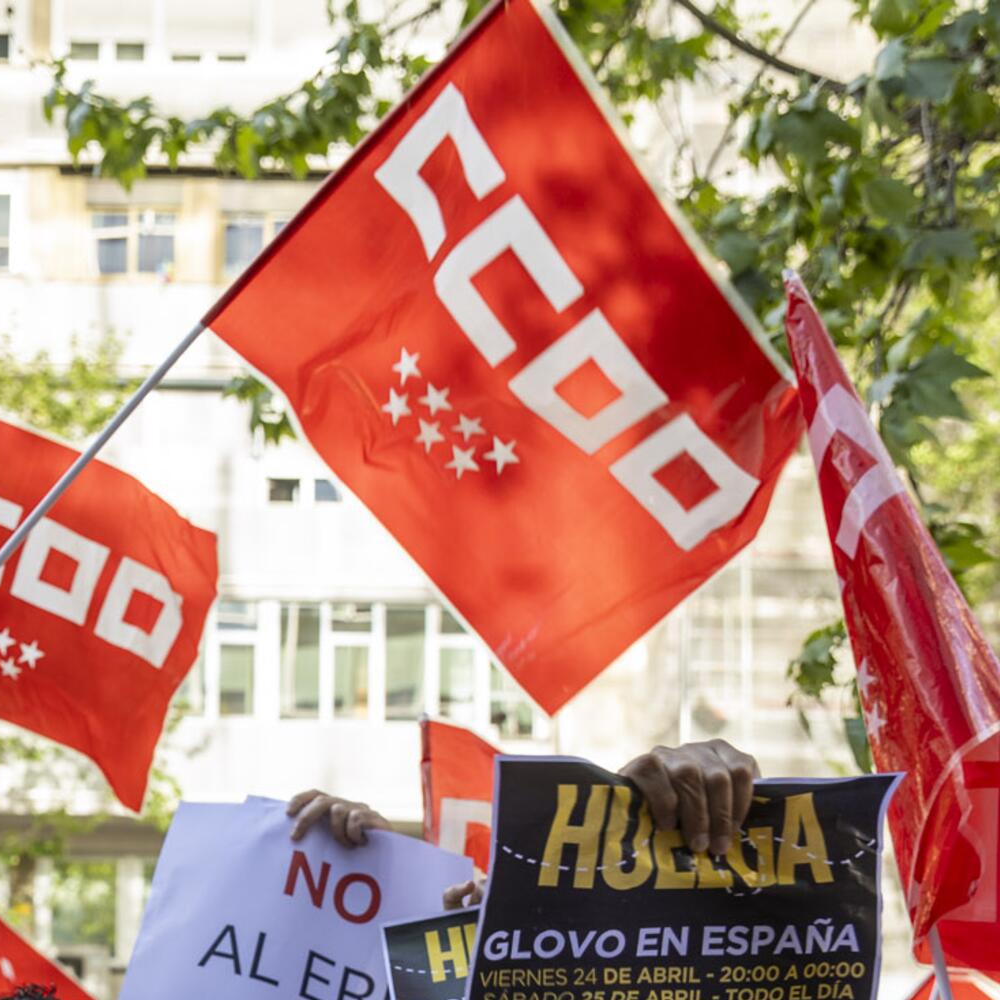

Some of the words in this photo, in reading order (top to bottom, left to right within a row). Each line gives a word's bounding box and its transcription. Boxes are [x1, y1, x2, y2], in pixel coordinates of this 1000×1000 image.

[374, 81, 761, 552] CCOO
[283, 849, 383, 925] NO
[197, 924, 280, 988] AL
[483, 928, 626, 961] GLOVO
[636, 926, 689, 957] EN
[701, 918, 860, 956] ESPAÑA
[480, 968, 567, 988] VIERNES
[573, 967, 598, 986] 24
[603, 967, 632, 985] DE
[636, 966, 701, 984] ABRIL
[719, 966, 780, 983] 20:00
[784, 965, 799, 980] A
[803, 962, 865, 979] 00:00
[788, 985, 812, 1000] EL
[817, 980, 855, 1000] DÍA
